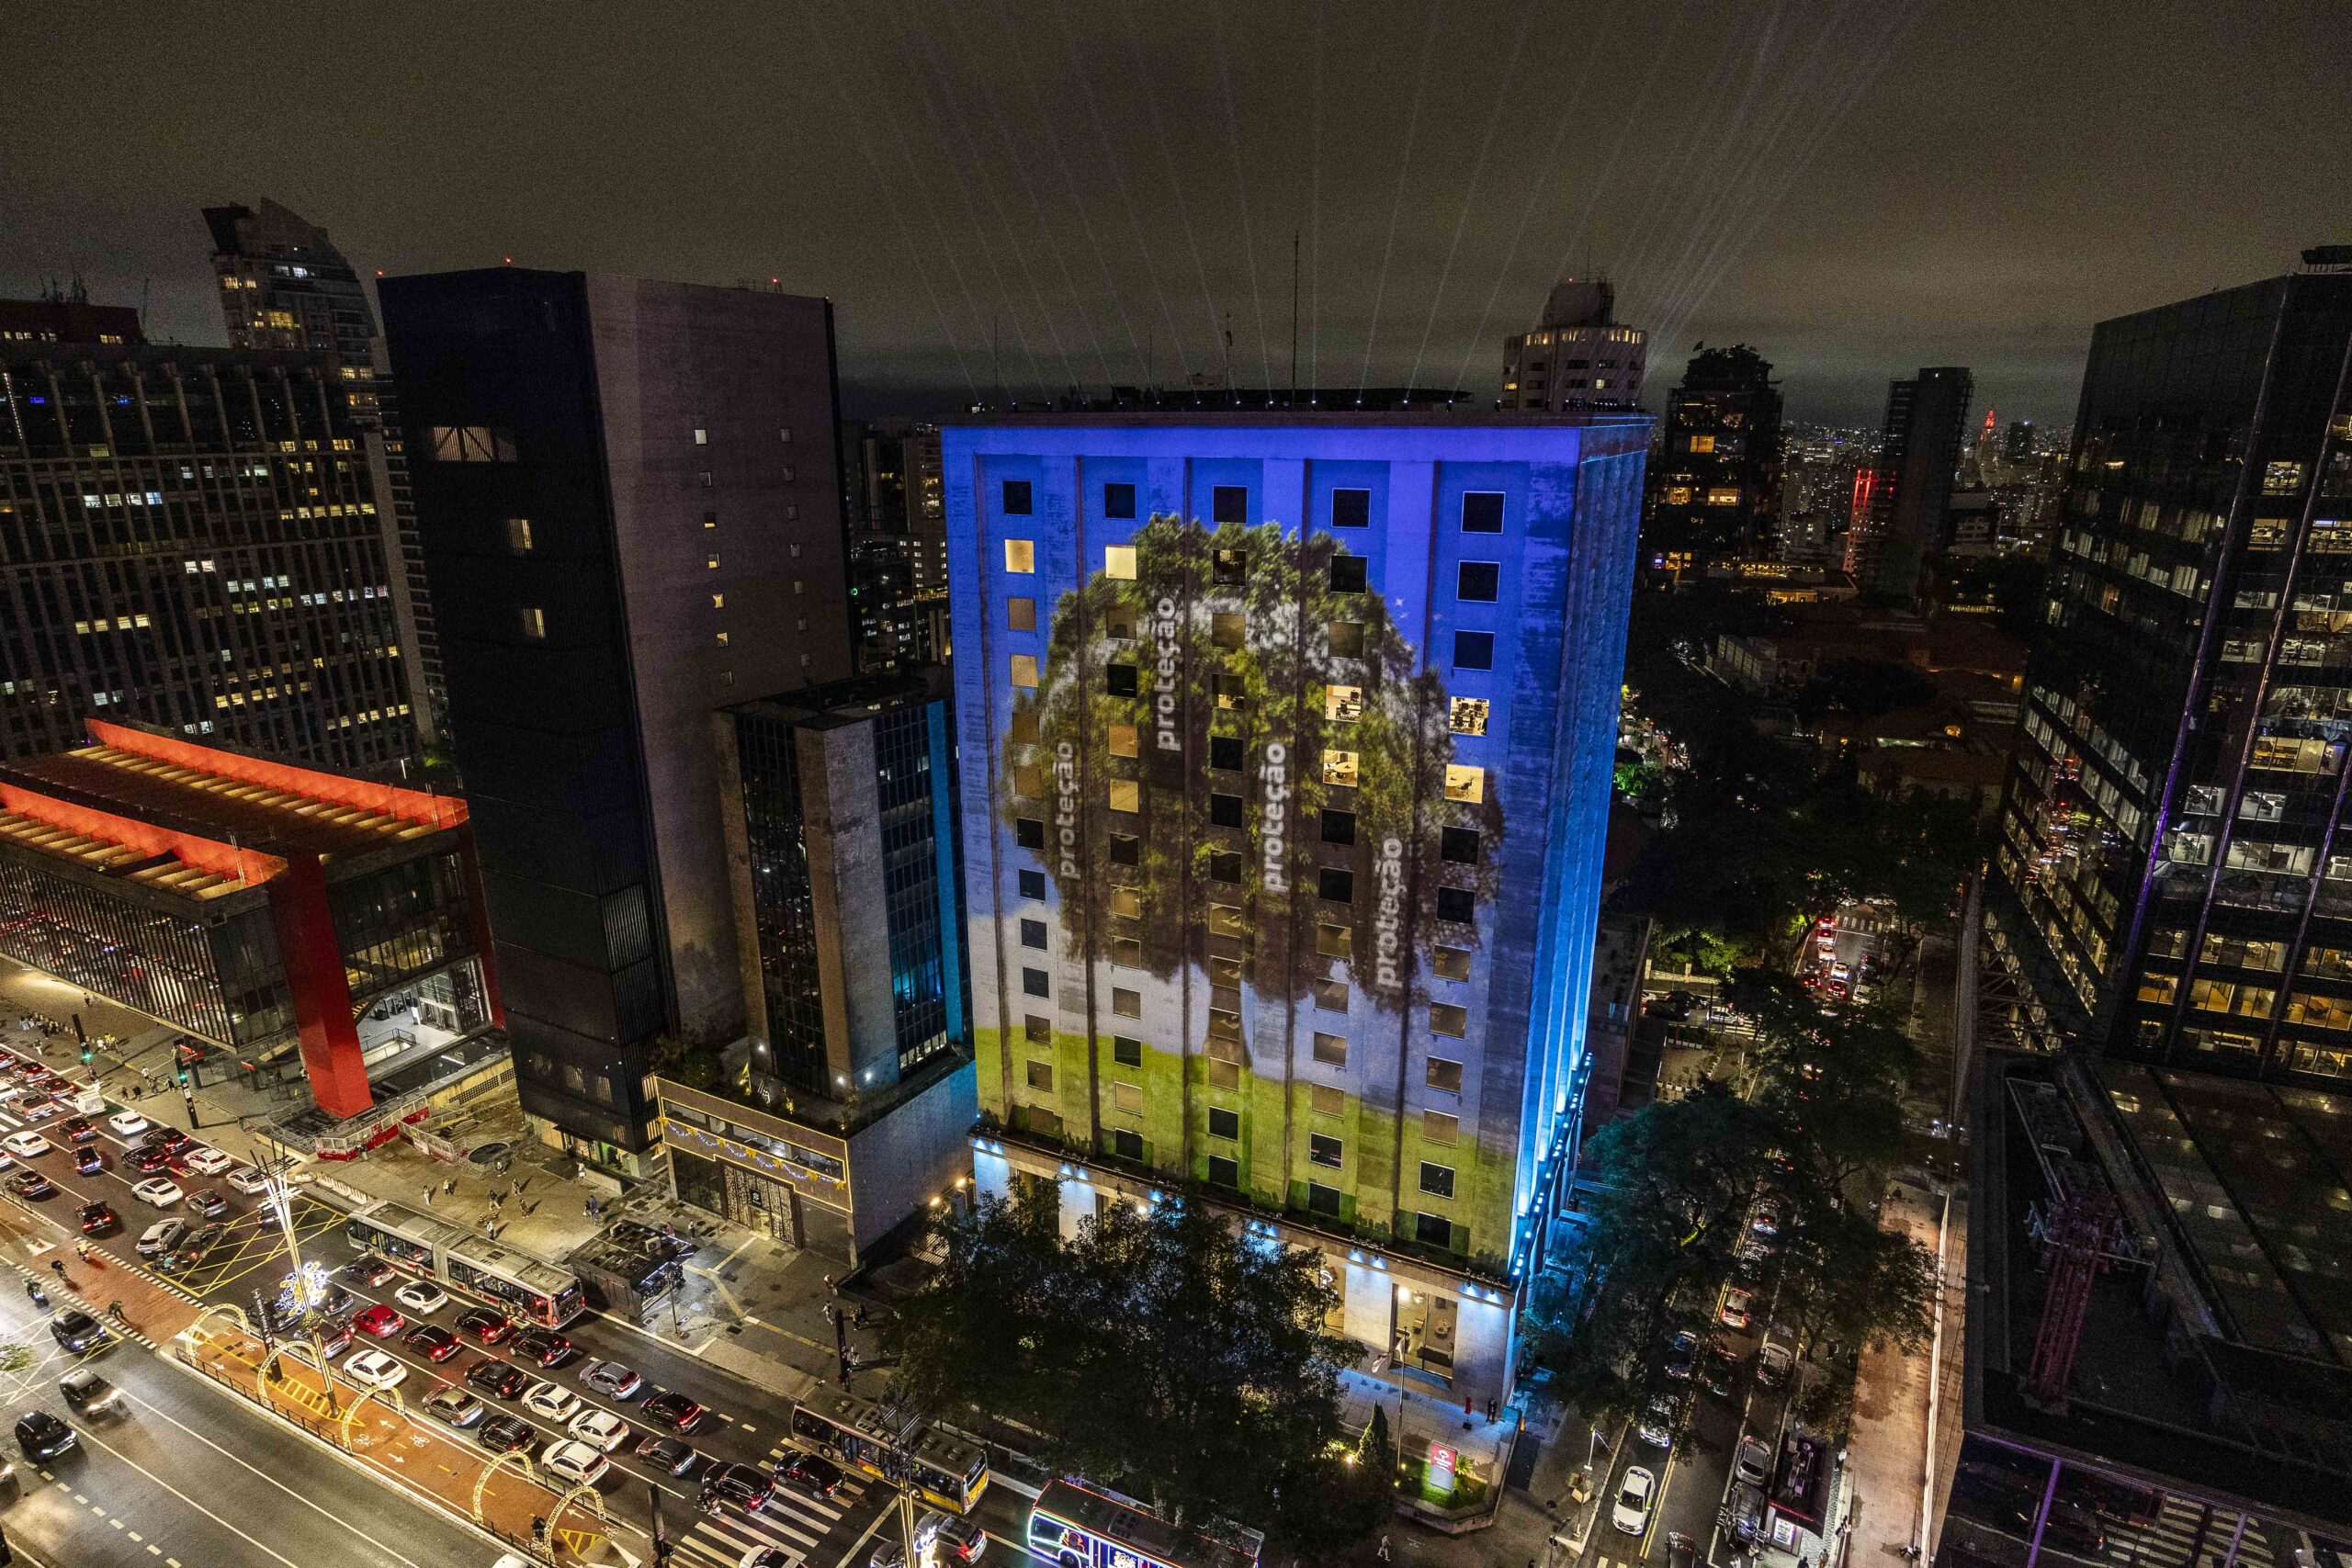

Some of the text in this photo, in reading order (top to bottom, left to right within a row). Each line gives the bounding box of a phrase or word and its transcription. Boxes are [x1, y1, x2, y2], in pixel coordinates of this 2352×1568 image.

[1151, 597, 1182, 751] proteção
[1052, 742, 1081, 880] proteção
[1259, 741, 1291, 892] proteção
[1374, 838, 1408, 989] proteção
[1716, 1506, 1728, 1526] TAXI
